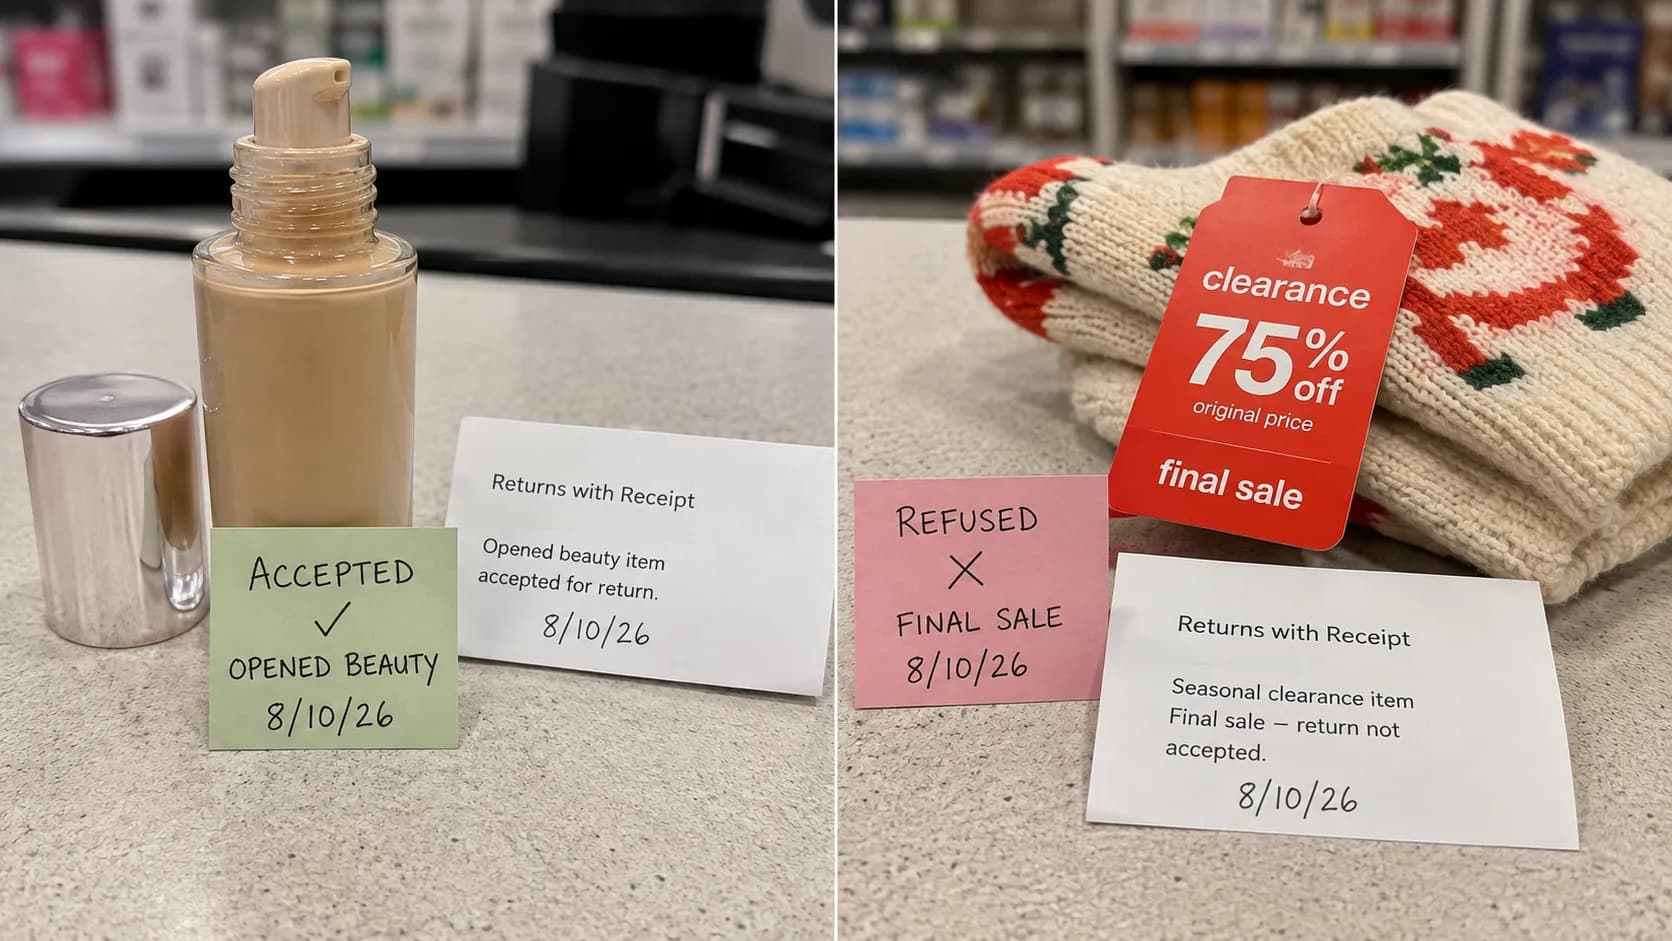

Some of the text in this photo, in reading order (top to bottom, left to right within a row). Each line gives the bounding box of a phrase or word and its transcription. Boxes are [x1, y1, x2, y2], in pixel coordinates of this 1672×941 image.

[1201, 266, 1371, 310] clearance
[1293, 376, 1345, 406] off
[1193, 400, 1313, 432] original price
[491, 472, 696, 513] Returns with Receipt
[1158, 458, 1303, 510] final sale
[895, 505, 1038, 538] REFUSED
[482, 537, 665, 572] Opened beauty item
[248, 555, 414, 592] ACCEPTED
[477, 570, 659, 601] accepted for return.
[542, 610, 650, 650] 8/10/26
[896, 605, 1064, 638] FINAL SALE
[1177, 614, 1412, 651] Returns with Receipt
[228, 651, 439, 687] OPENED BEAUTY
[907, 647, 1028, 690] 8/10/26
[1171, 677, 1414, 710] Seasonal clearance item
[267, 695, 394, 738] 8/10/26
[1169, 706, 1218, 728] Final
[1224, 711, 1266, 731] sale
[1297, 718, 1359, 736] return
[1366, 722, 1401, 739] not
[1165, 742, 1267, 765] accepted.
[1238, 777, 1358, 820] 8/10/26
